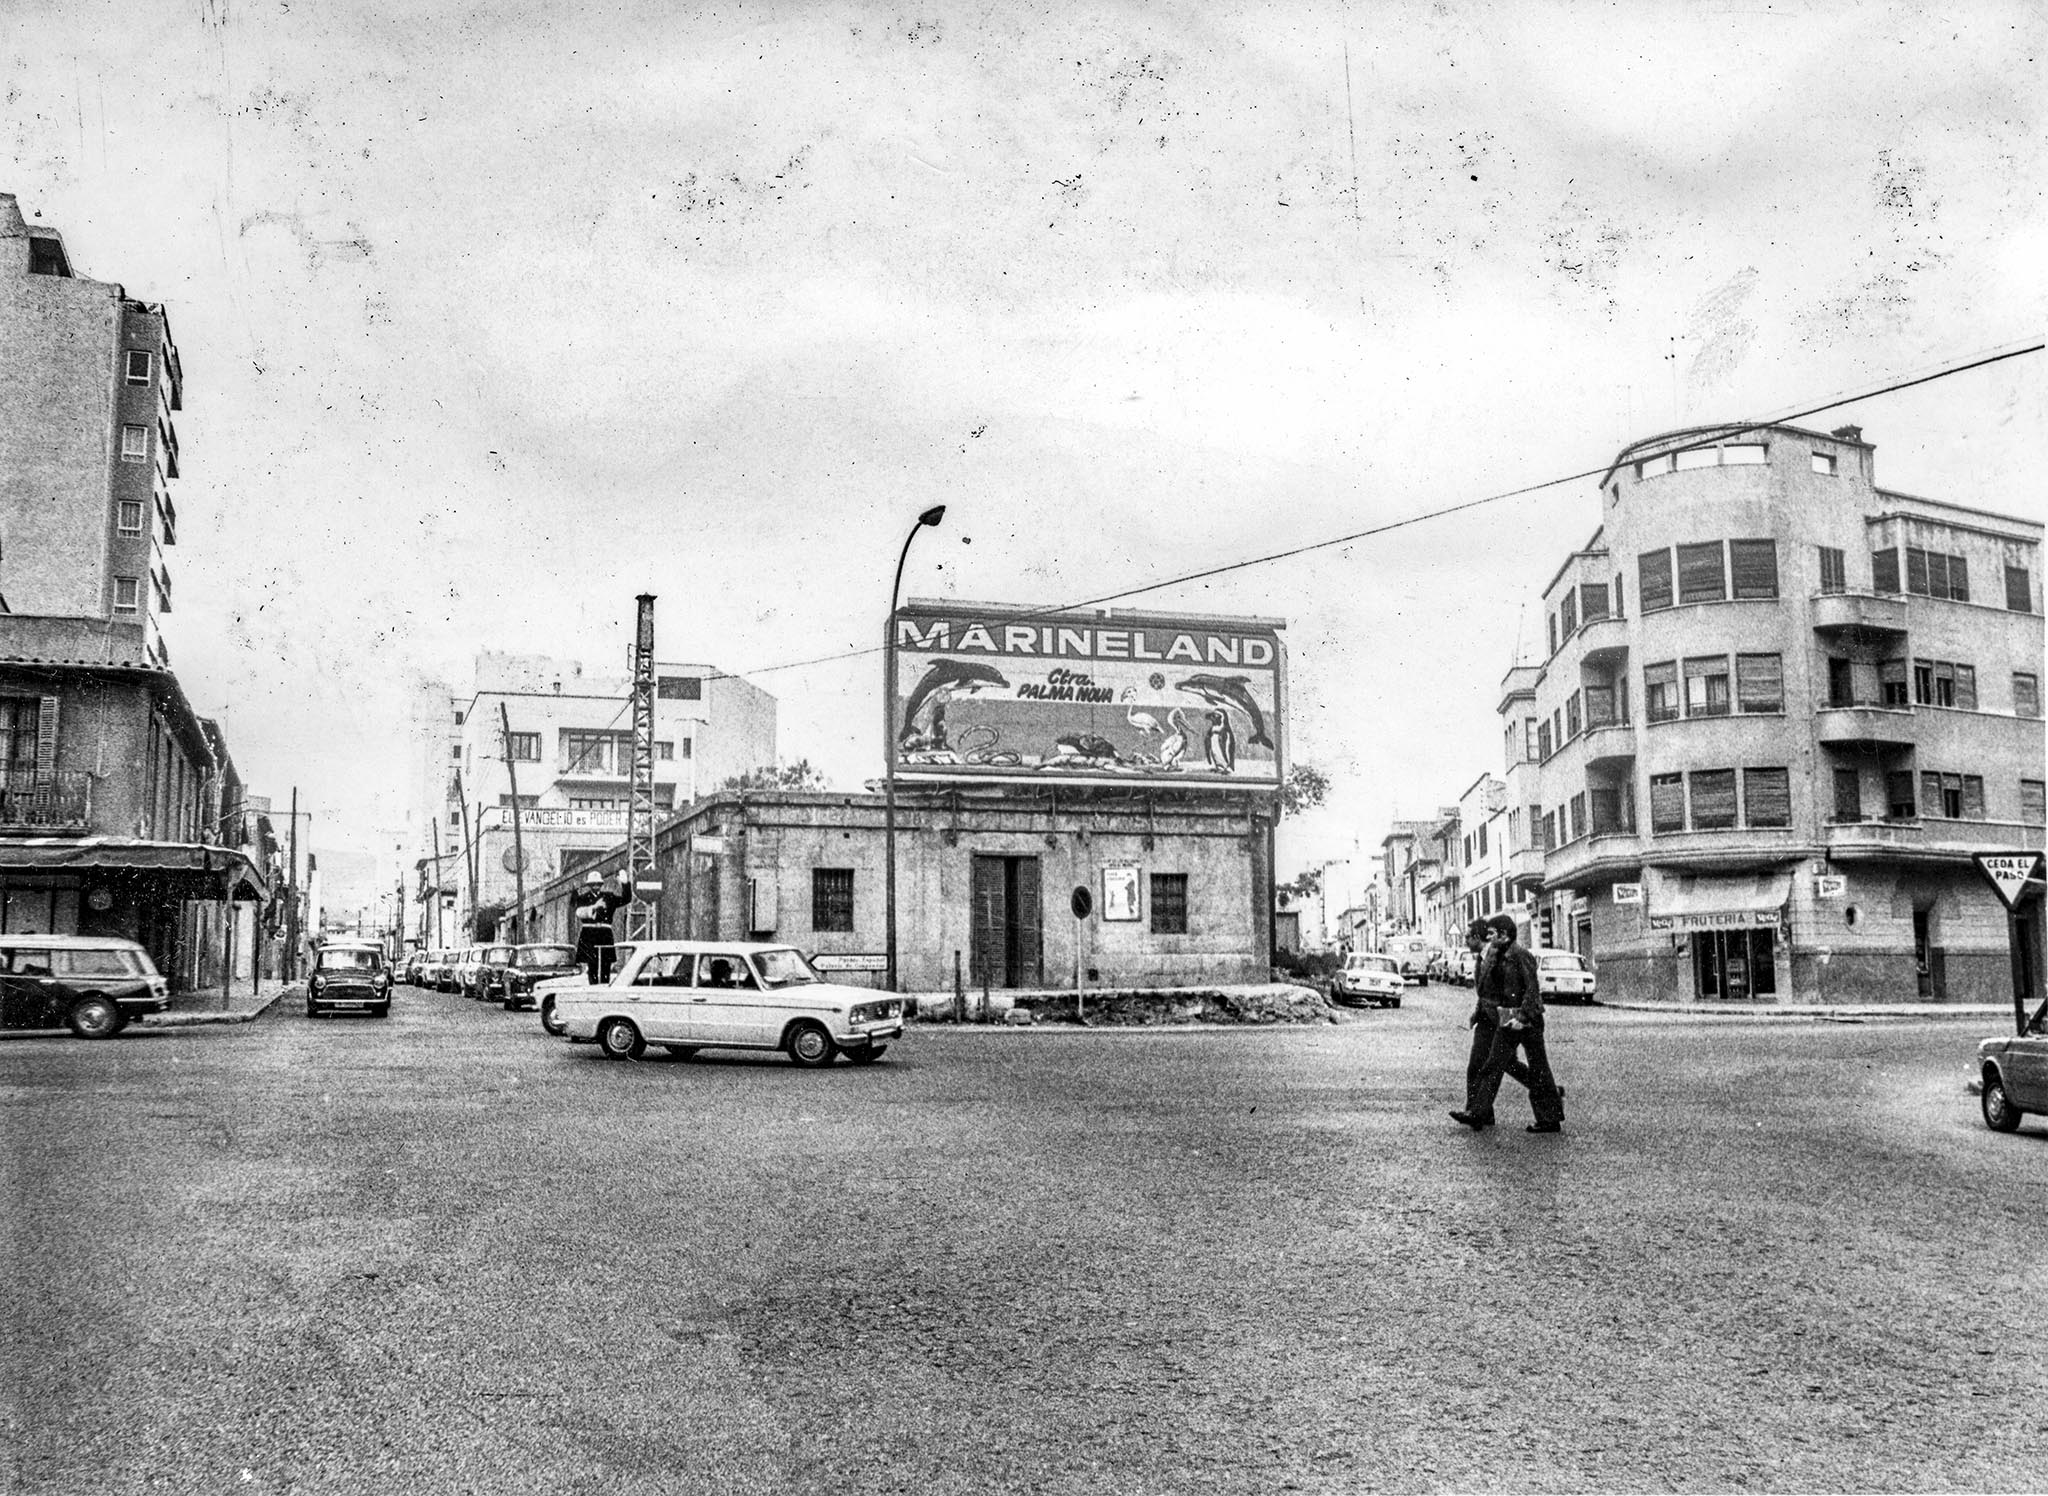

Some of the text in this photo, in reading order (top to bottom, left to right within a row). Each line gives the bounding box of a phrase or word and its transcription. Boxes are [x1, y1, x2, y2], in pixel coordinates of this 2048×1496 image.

[897, 620, 1274, 665] MARINELAND
[1047, 668, 1095, 686] Ctra.
[1017, 683, 1074, 701] PALMA
[502, 809, 513, 824] EL
[519, 811, 573, 825] VANGELIO
[576, 816, 587, 825] es
[1986, 858, 2030, 869] CEDA EL
[1995, 870, 2025, 880] PASO
[1682, 913, 1746, 927] FRUTERIA
